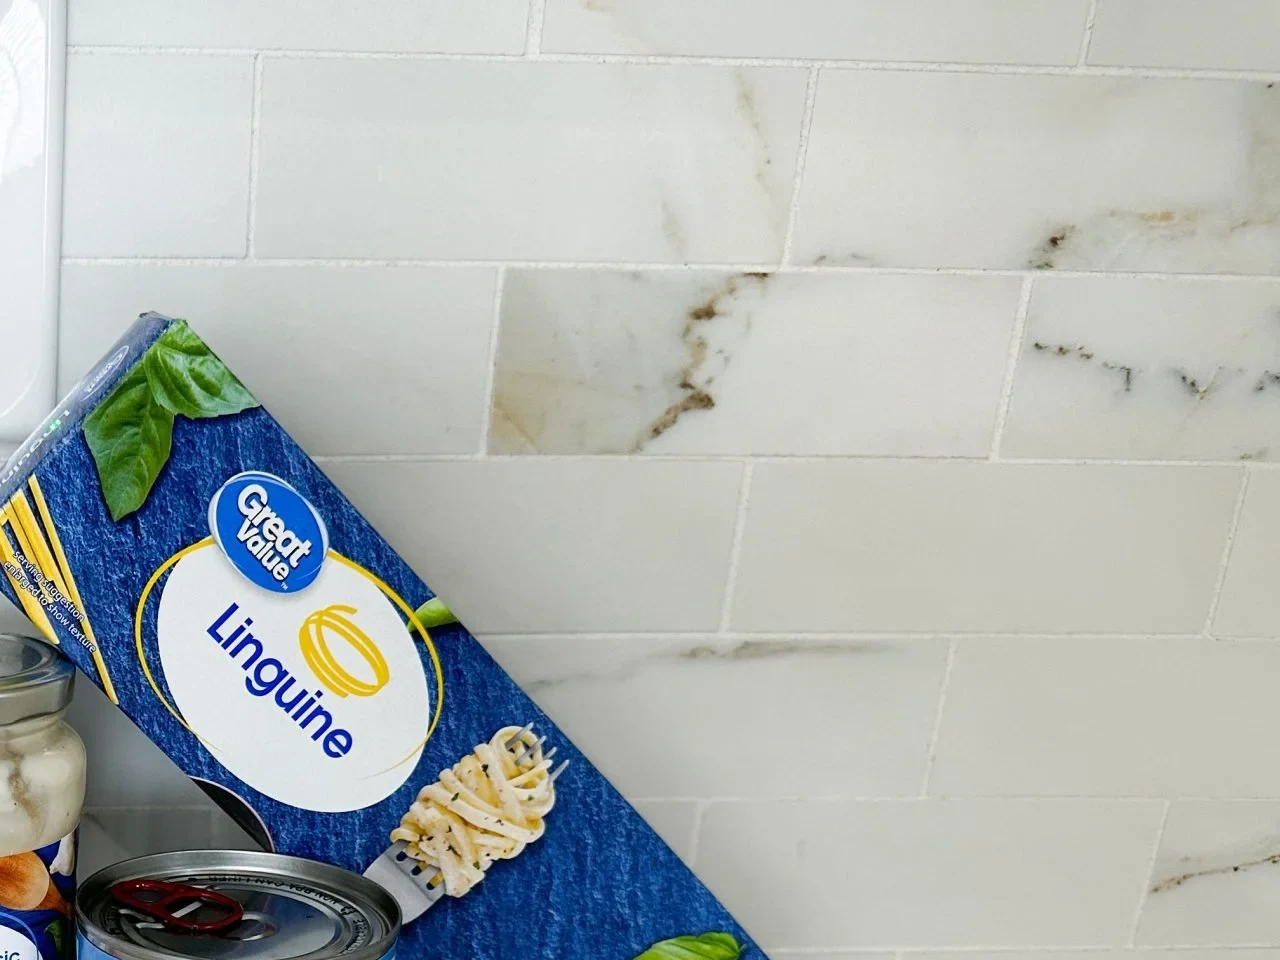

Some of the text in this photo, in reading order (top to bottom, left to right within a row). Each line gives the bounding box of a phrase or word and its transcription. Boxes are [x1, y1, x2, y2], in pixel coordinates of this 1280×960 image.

[236, 518, 290, 581] Value
[237, 483, 313, 569] Great
[3, 562, 97, 654] enlarged to show texture
[13, 551, 86, 623] serving suggestion
[205, 602, 354, 759] Linguine
